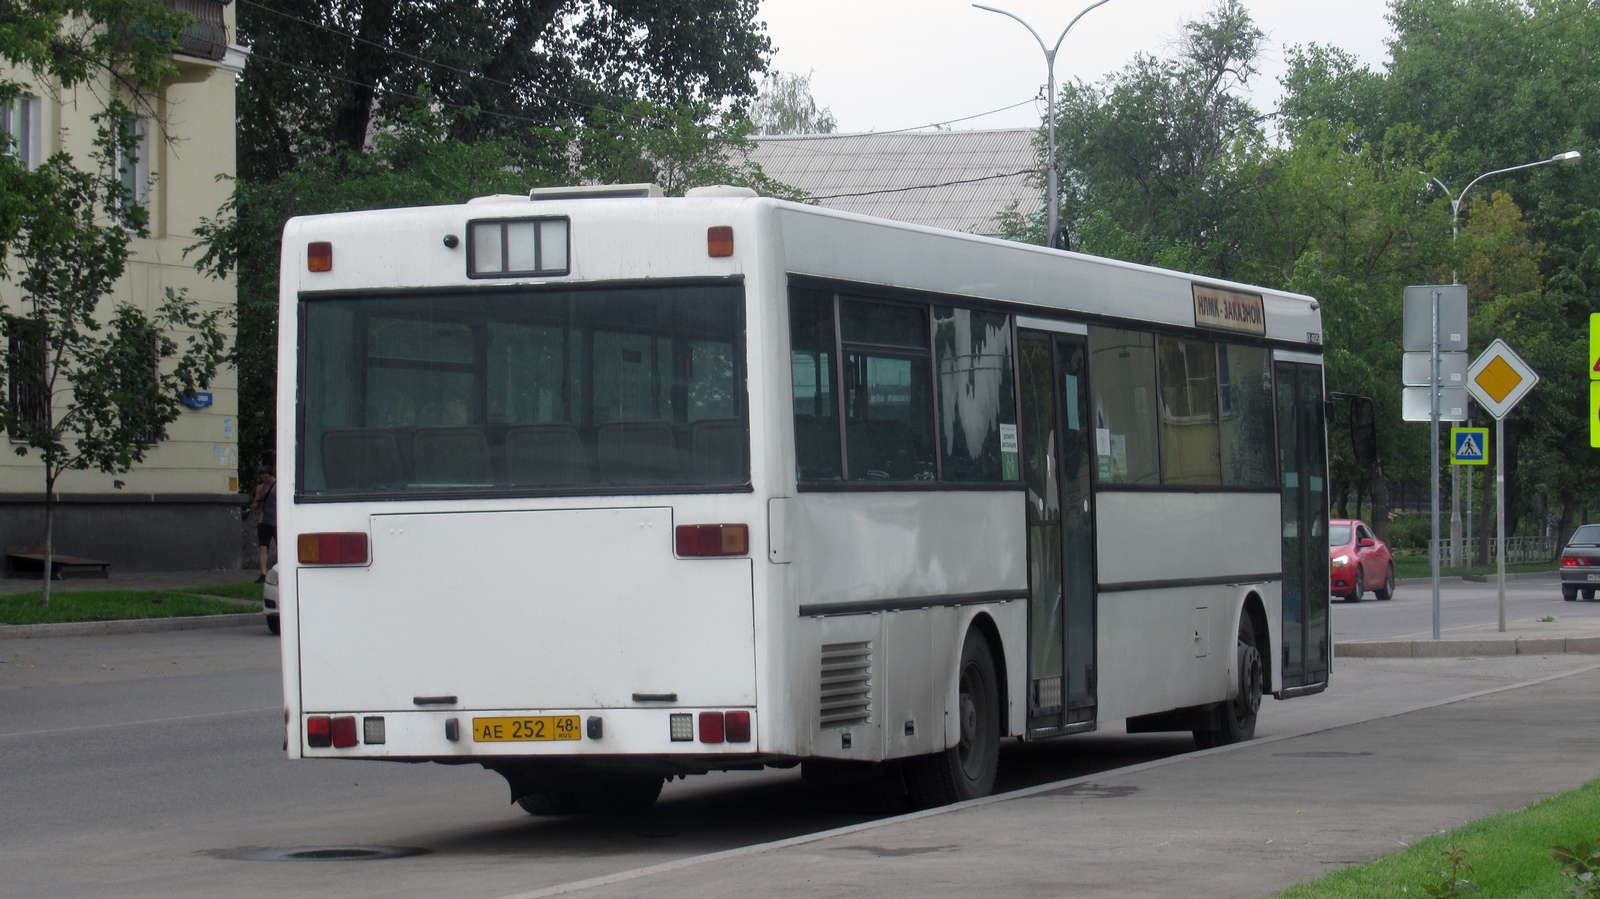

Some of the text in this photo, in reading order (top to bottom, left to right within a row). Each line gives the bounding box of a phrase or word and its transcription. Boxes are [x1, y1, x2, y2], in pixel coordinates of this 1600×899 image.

[1198, 295, 1220, 318] НЛМК
[1223, 301, 1261, 325] ЗАКАЗНОЙ
[512, 720, 545, 738] 252
[556, 718, 573, 732] 48
